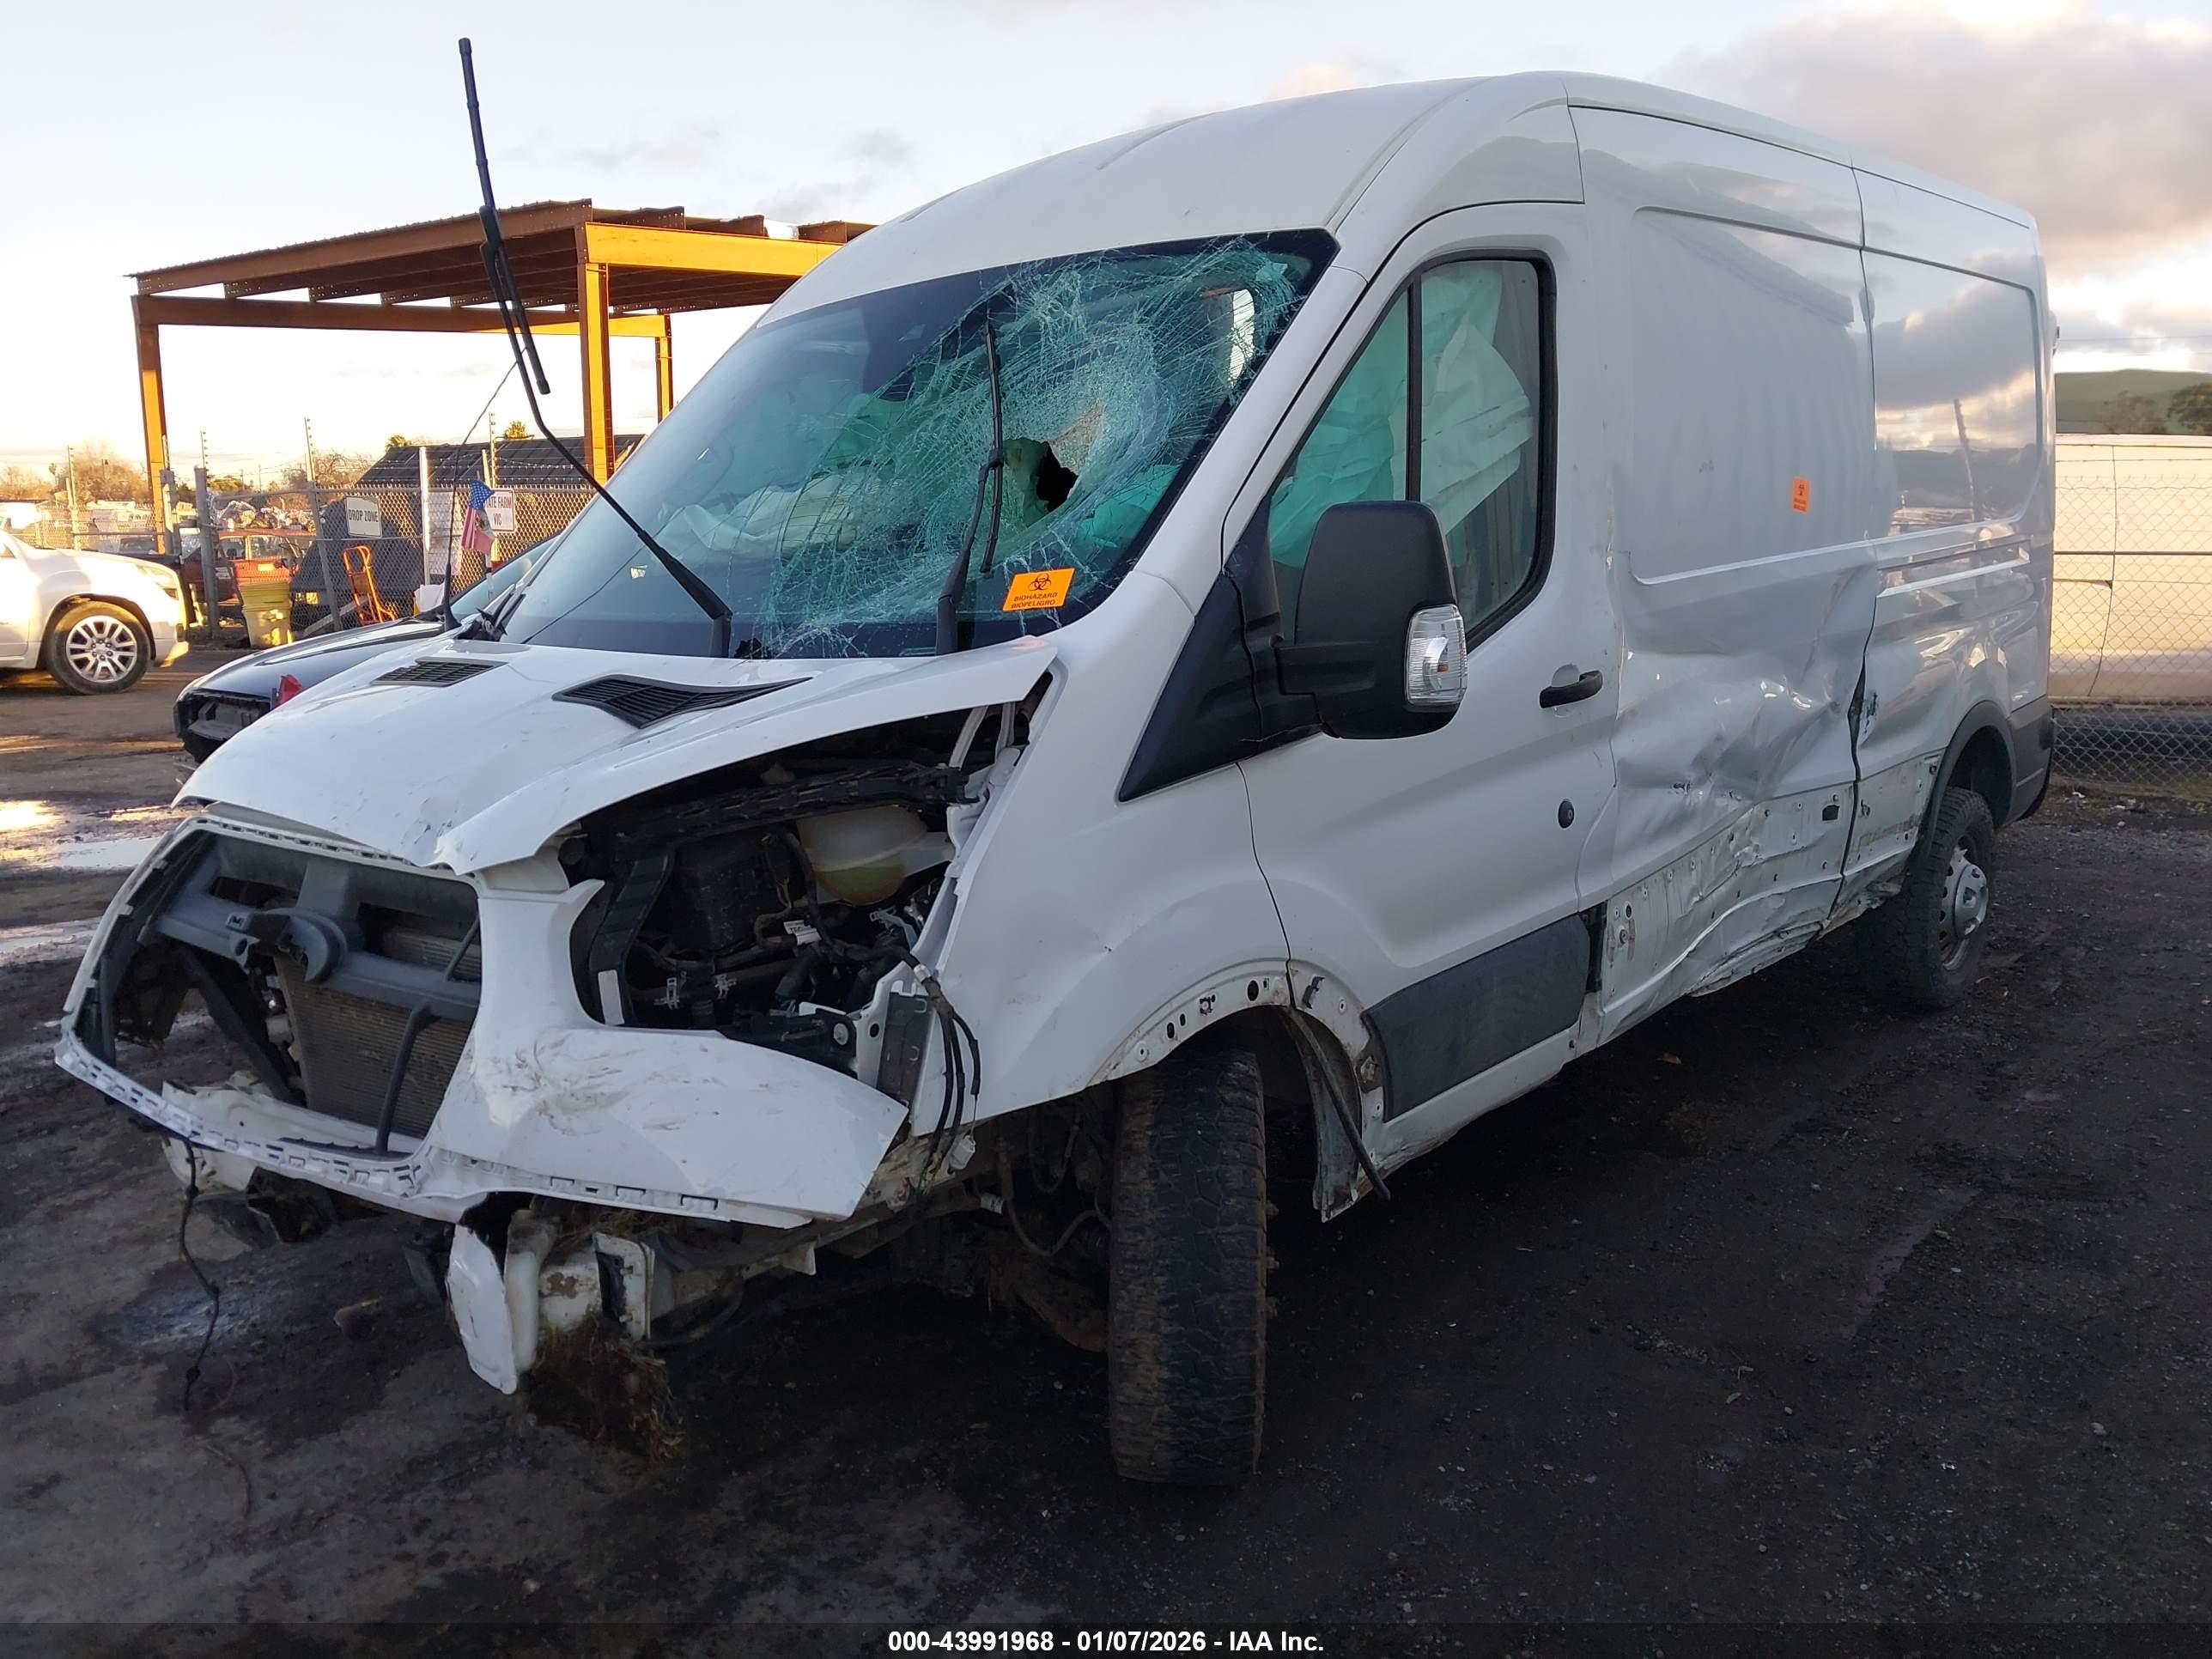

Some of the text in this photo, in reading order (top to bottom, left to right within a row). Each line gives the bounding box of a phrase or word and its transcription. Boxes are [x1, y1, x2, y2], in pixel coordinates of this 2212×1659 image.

[483, 495, 512, 509] TATE FARM
[348, 509, 379, 523] DROP ZONE
[493, 513, 502, 526] VIC
[1013, 592, 1058, 602] BIOHAZARD
[1011, 599, 1056, 609] BIOPELIGRO
